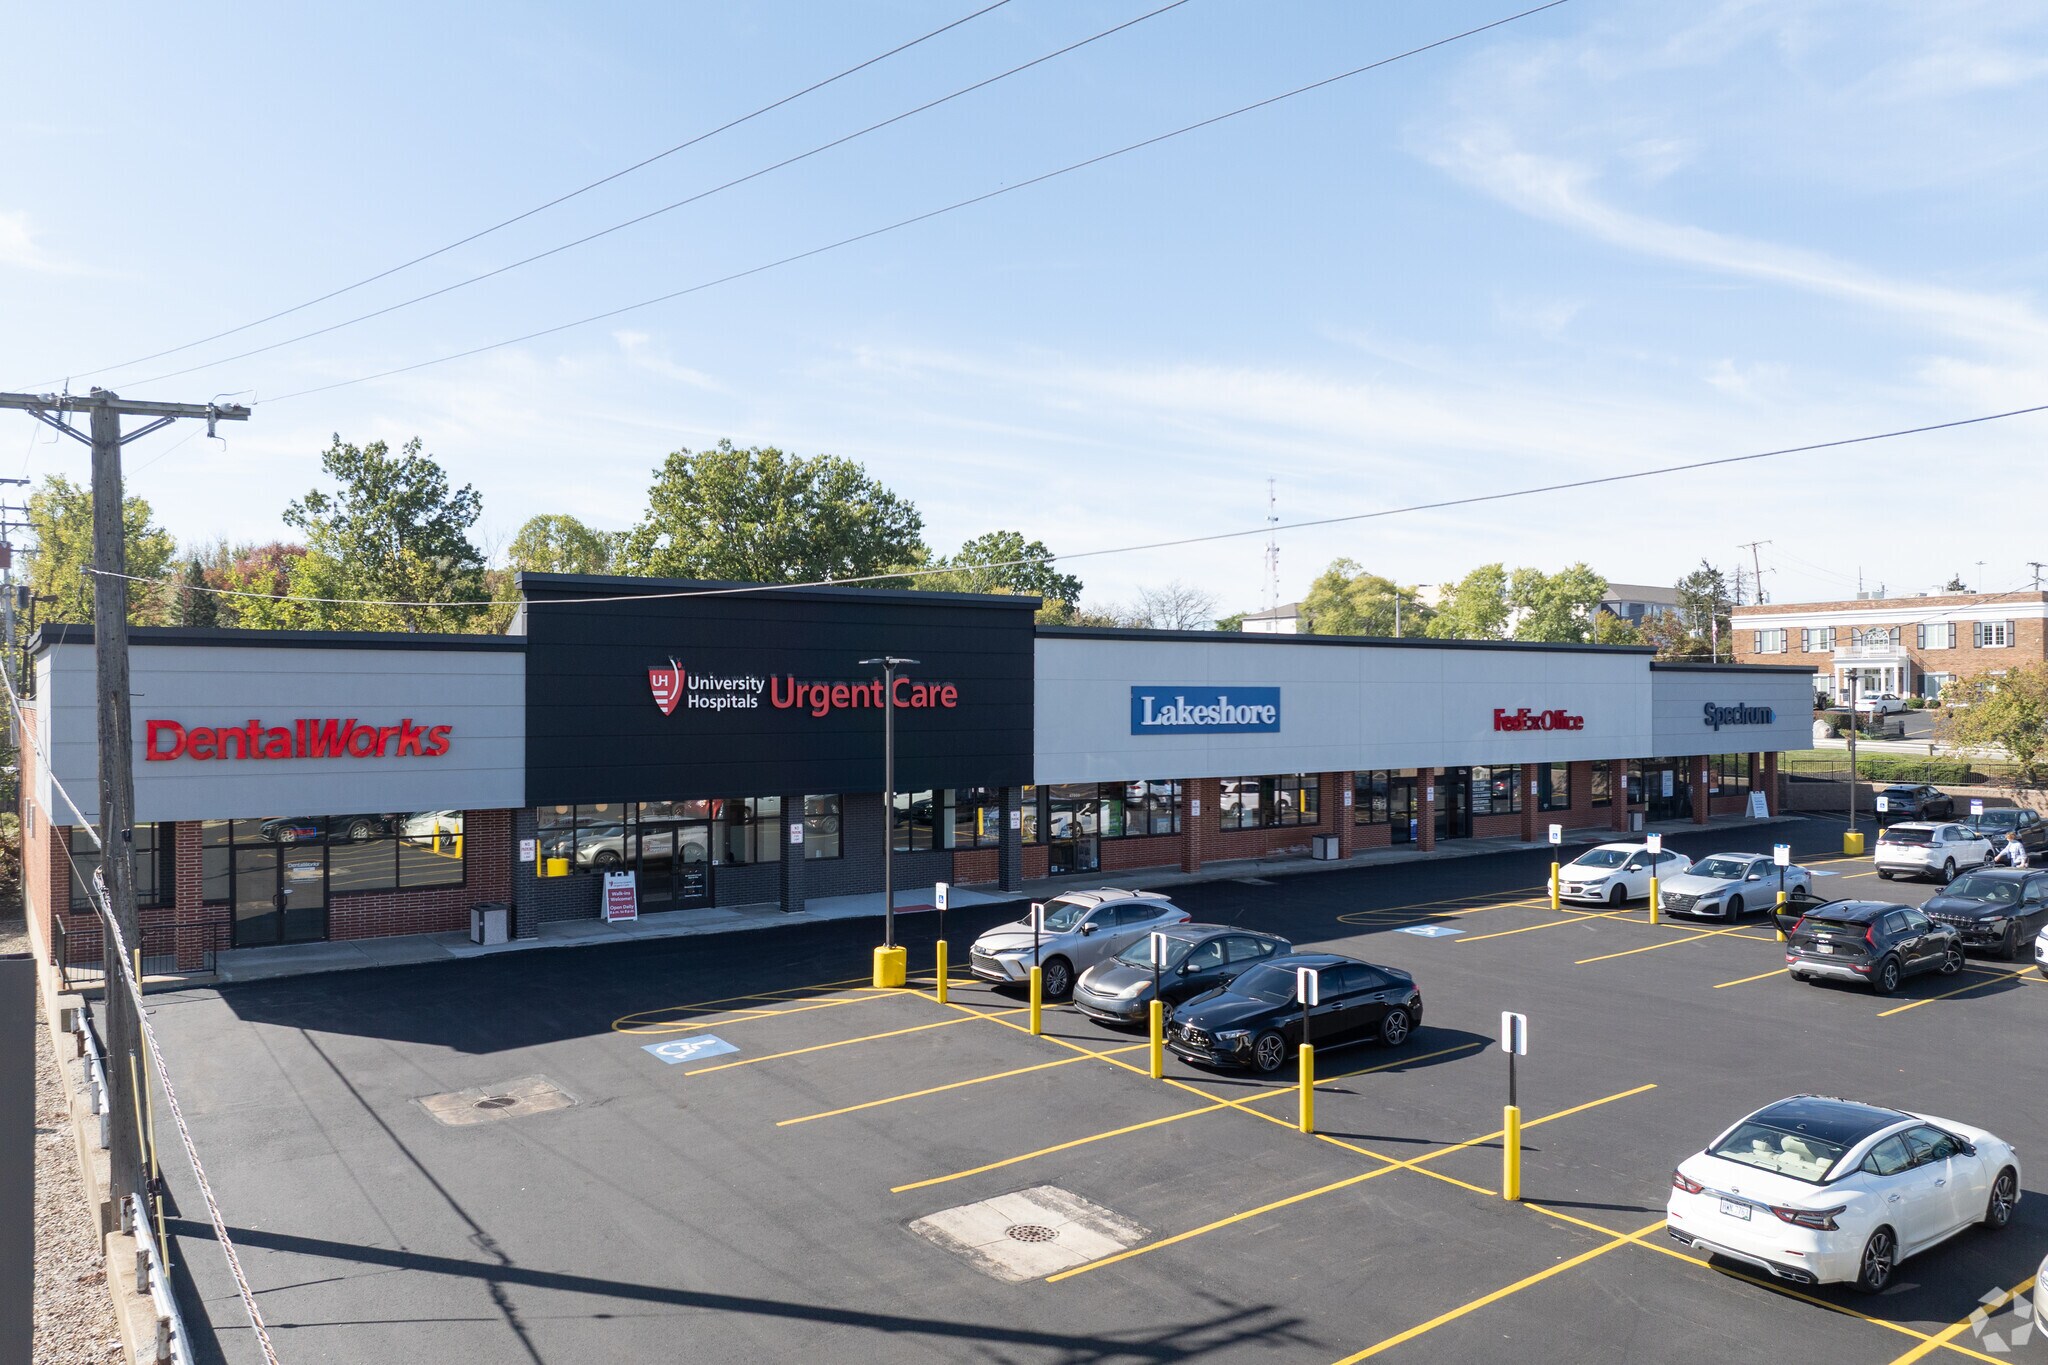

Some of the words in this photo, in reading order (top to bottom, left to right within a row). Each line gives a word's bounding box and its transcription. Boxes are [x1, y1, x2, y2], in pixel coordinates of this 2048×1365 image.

[652, 675, 668, 687] UH
[688, 675, 765, 694] University
[688, 694, 758, 711] Hospitals
[770, 677, 884, 718] Urgent
[892, 678, 958, 708] Care
[1141, 696, 1276, 726] Lakeshore
[1704, 702, 1773, 731] Spectrum
[146, 719, 453, 761] DentalWorks
